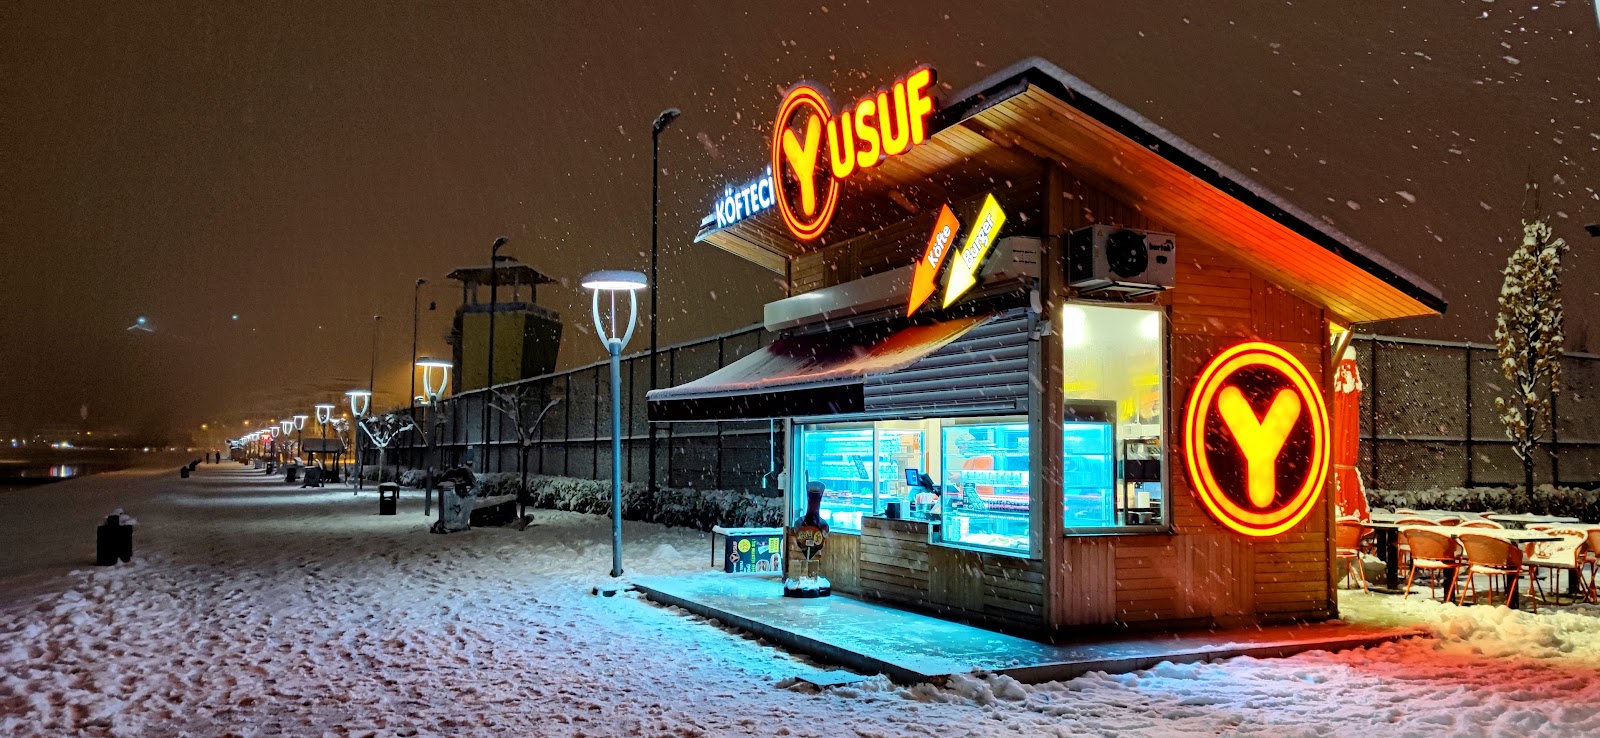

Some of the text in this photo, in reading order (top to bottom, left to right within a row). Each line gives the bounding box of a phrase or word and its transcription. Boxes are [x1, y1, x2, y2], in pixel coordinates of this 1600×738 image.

[715, 165, 776, 229] KÖFTECİ
[927, 224, 951, 269] Köfte
[961, 212, 995, 270] Burger
[1217, 385, 1302, 509] Y
